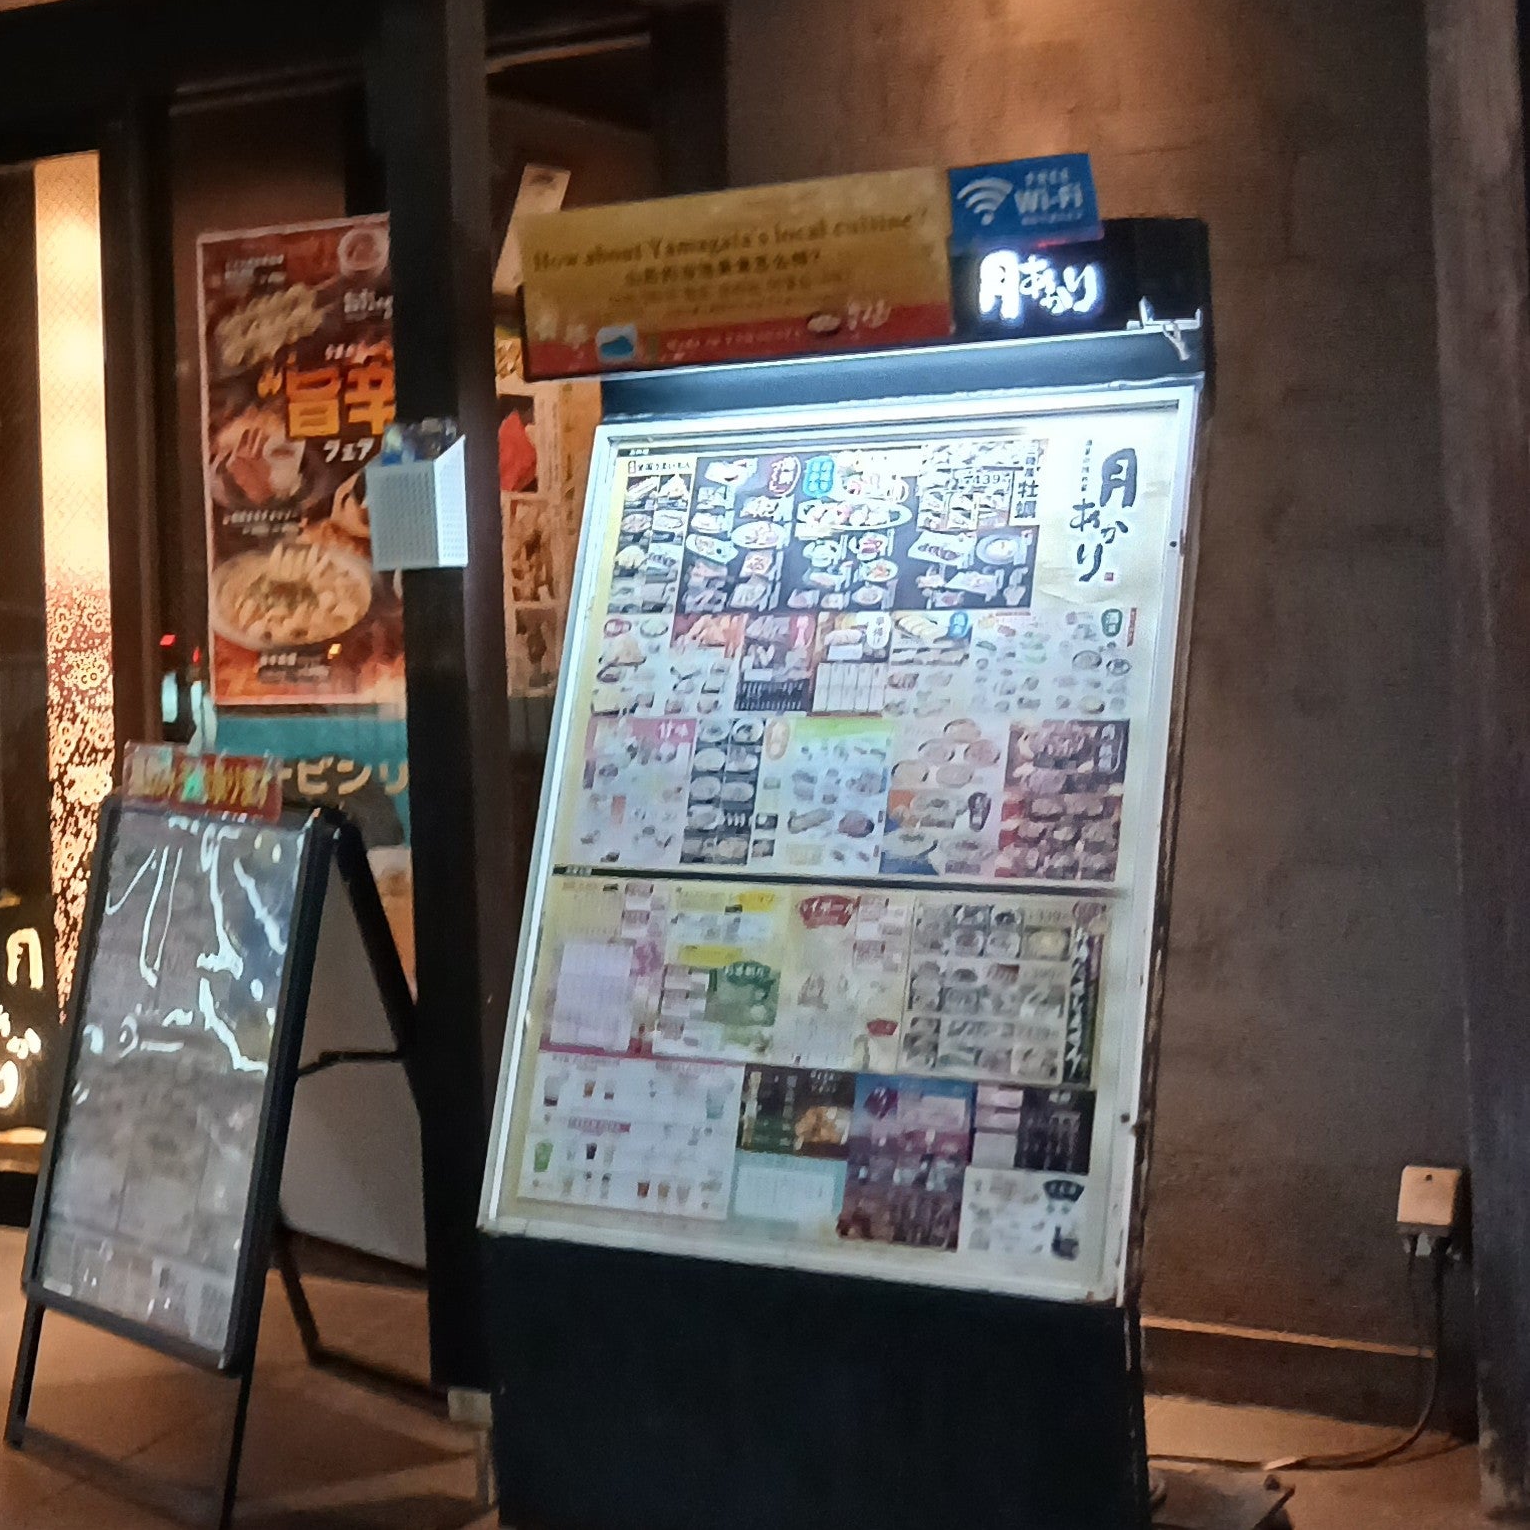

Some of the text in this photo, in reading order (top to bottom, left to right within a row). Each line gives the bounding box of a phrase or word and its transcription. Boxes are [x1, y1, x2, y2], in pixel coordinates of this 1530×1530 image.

[978, 250, 1097, 320] 月あかり
[1070, 447, 1138, 582] 月あかり
